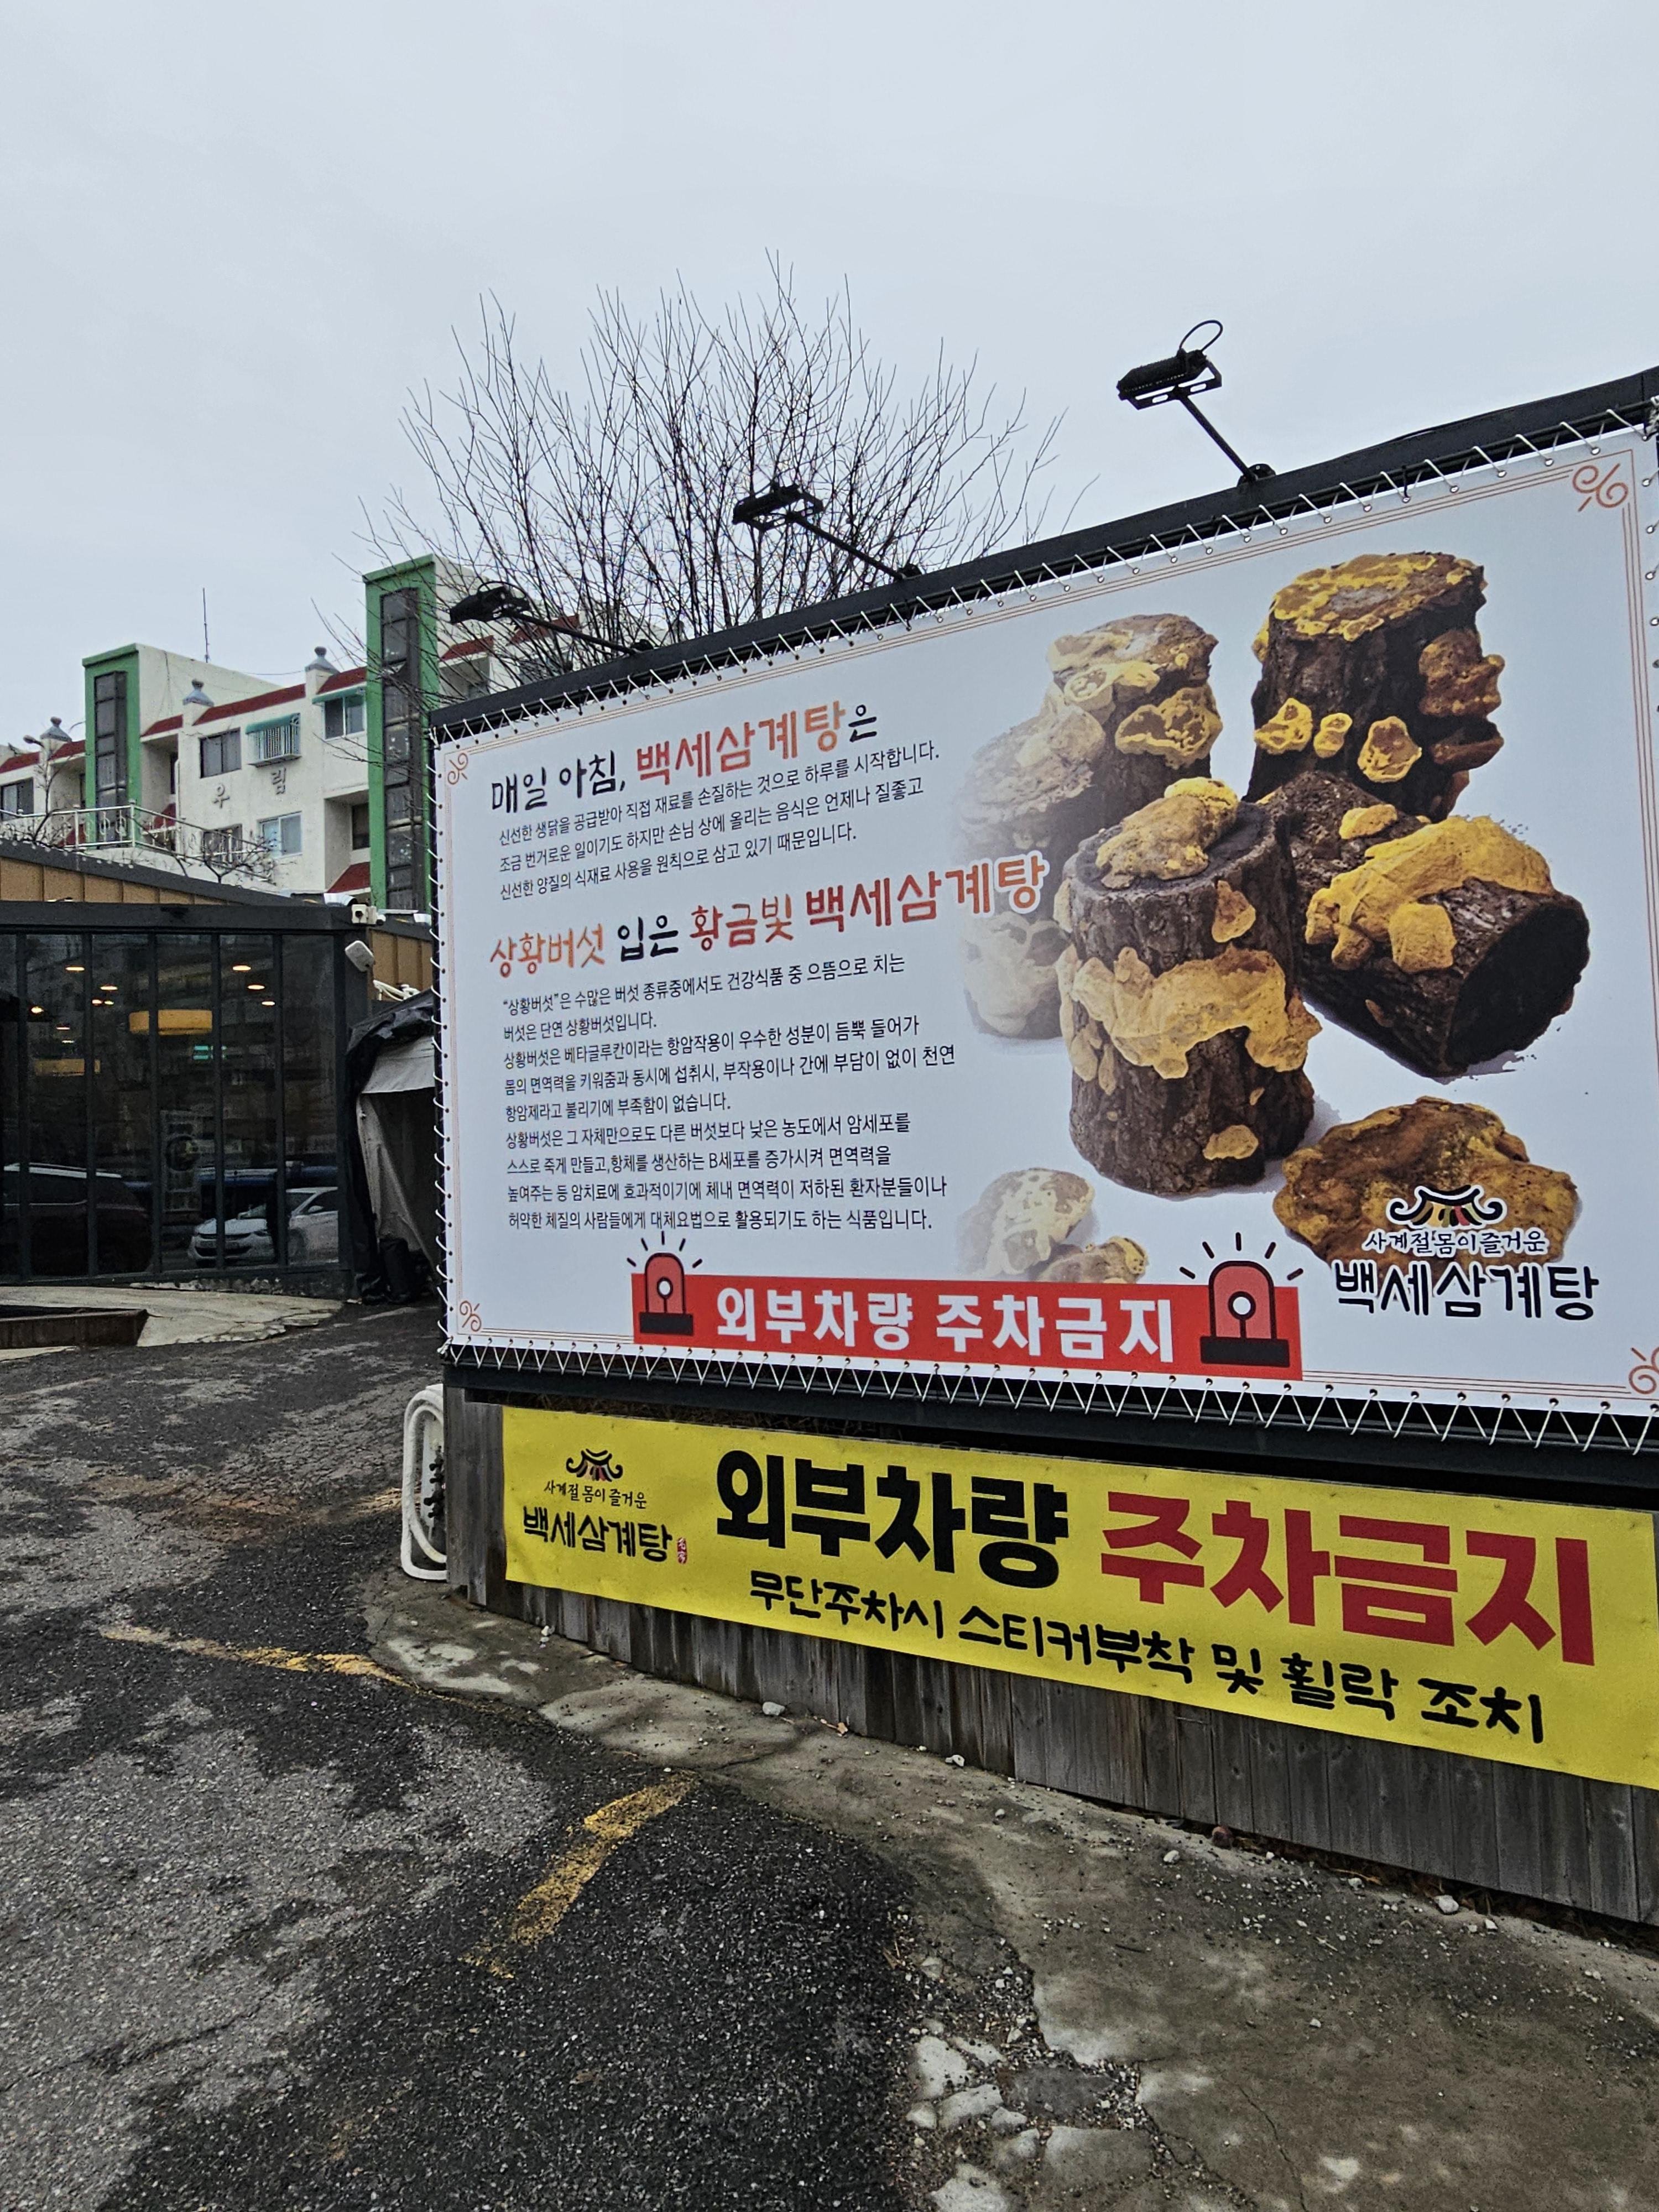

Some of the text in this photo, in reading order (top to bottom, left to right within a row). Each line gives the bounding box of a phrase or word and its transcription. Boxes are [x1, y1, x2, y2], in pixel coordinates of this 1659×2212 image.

[491, 700, 877, 813] 매일 아침, 백세삼계탕은
[499, 740, 940, 847] 신선한 생닭을 공급받아 직접 재료를 손질하는 것으로 하루를 시작합니다.
[499, 777, 924, 873] 조금 번거로운 일이기도 하지만 손님 상에 올리는 음식은 언제나 질좋고
[500, 821, 857, 901] 신선한 양질의 식재료 사용을 원칙으로 삼고 있기 때문입니다.
[490, 855, 1045, 977] 상황버섯 입은 황금빛 백세삼계탕
[574, 988, 612, 1009] 수많은
[614, 983, 639, 1003] 버섯
[643, 975, 723, 1001] 종류중에서도
[727, 967, 784, 992] 건강식품
[787, 964, 803, 985] 중
[806, 957, 869, 981] 으뜸으로
[873, 953, 905, 975] 치는
[503, 1010, 657, 1043] 버섯은 단연 상황버섯입니다.
[503, 1015, 920, 1070] 상황버섯은 베타글루칸이라는 항암작용이 우수한 성분이 듬뿍 들어가
[530, 1074, 577, 1094] 면역력을
[580, 1070, 629, 1091] 키워줌과
[632, 1066, 671, 1087] 동시에
[674, 1062, 719, 1084] 섭취시,
[723, 1056, 795, 1081] 부작용이나
[799, 1053, 828, 1076] 간에
[833, 1050, 879, 1073] 부담이
[885, 1047, 916, 1070] 없이
[922, 1044, 955, 1067] 천연
[505, 1092, 731, 1123] 항암제라고 불리기에 부족함이 없습니다.
[505, 1112, 911, 1150] 상황버섯은 그 자체만으로도 다른 버섯보다 낮은 농도에서 암세포를
[507, 1158, 541, 1175] 스스로
[544, 1156, 567, 1175] 죽게
[651, 1152, 705, 1172] 생산하는
[708, 1150, 761, 1170] B세포를
[765, 1147, 823, 1169] 증가시켜
[829, 1145, 891, 1167] 면역력을
[507, 1175, 947, 1203] 높여주는 등 암치료에 효과적이기에 체내 면역력이 저하된 환자분들이나
[508, 1208, 932, 1230] 허약한 체질의 사람들에게 대체요법으로 활용되기도 하는 식품입니다.
[1334, 1262, 1599, 1321] 백세삼계탕
[716, 1287, 1174, 1363] 외부차량 주차금지
[523, 1505, 673, 1562] 백세삼계탕
[716, 1449, 1595, 1667] 외부차량 주차금지
[749, 1569, 1544, 1744] 무단주차시 스티커부착 및 휠락 조치
